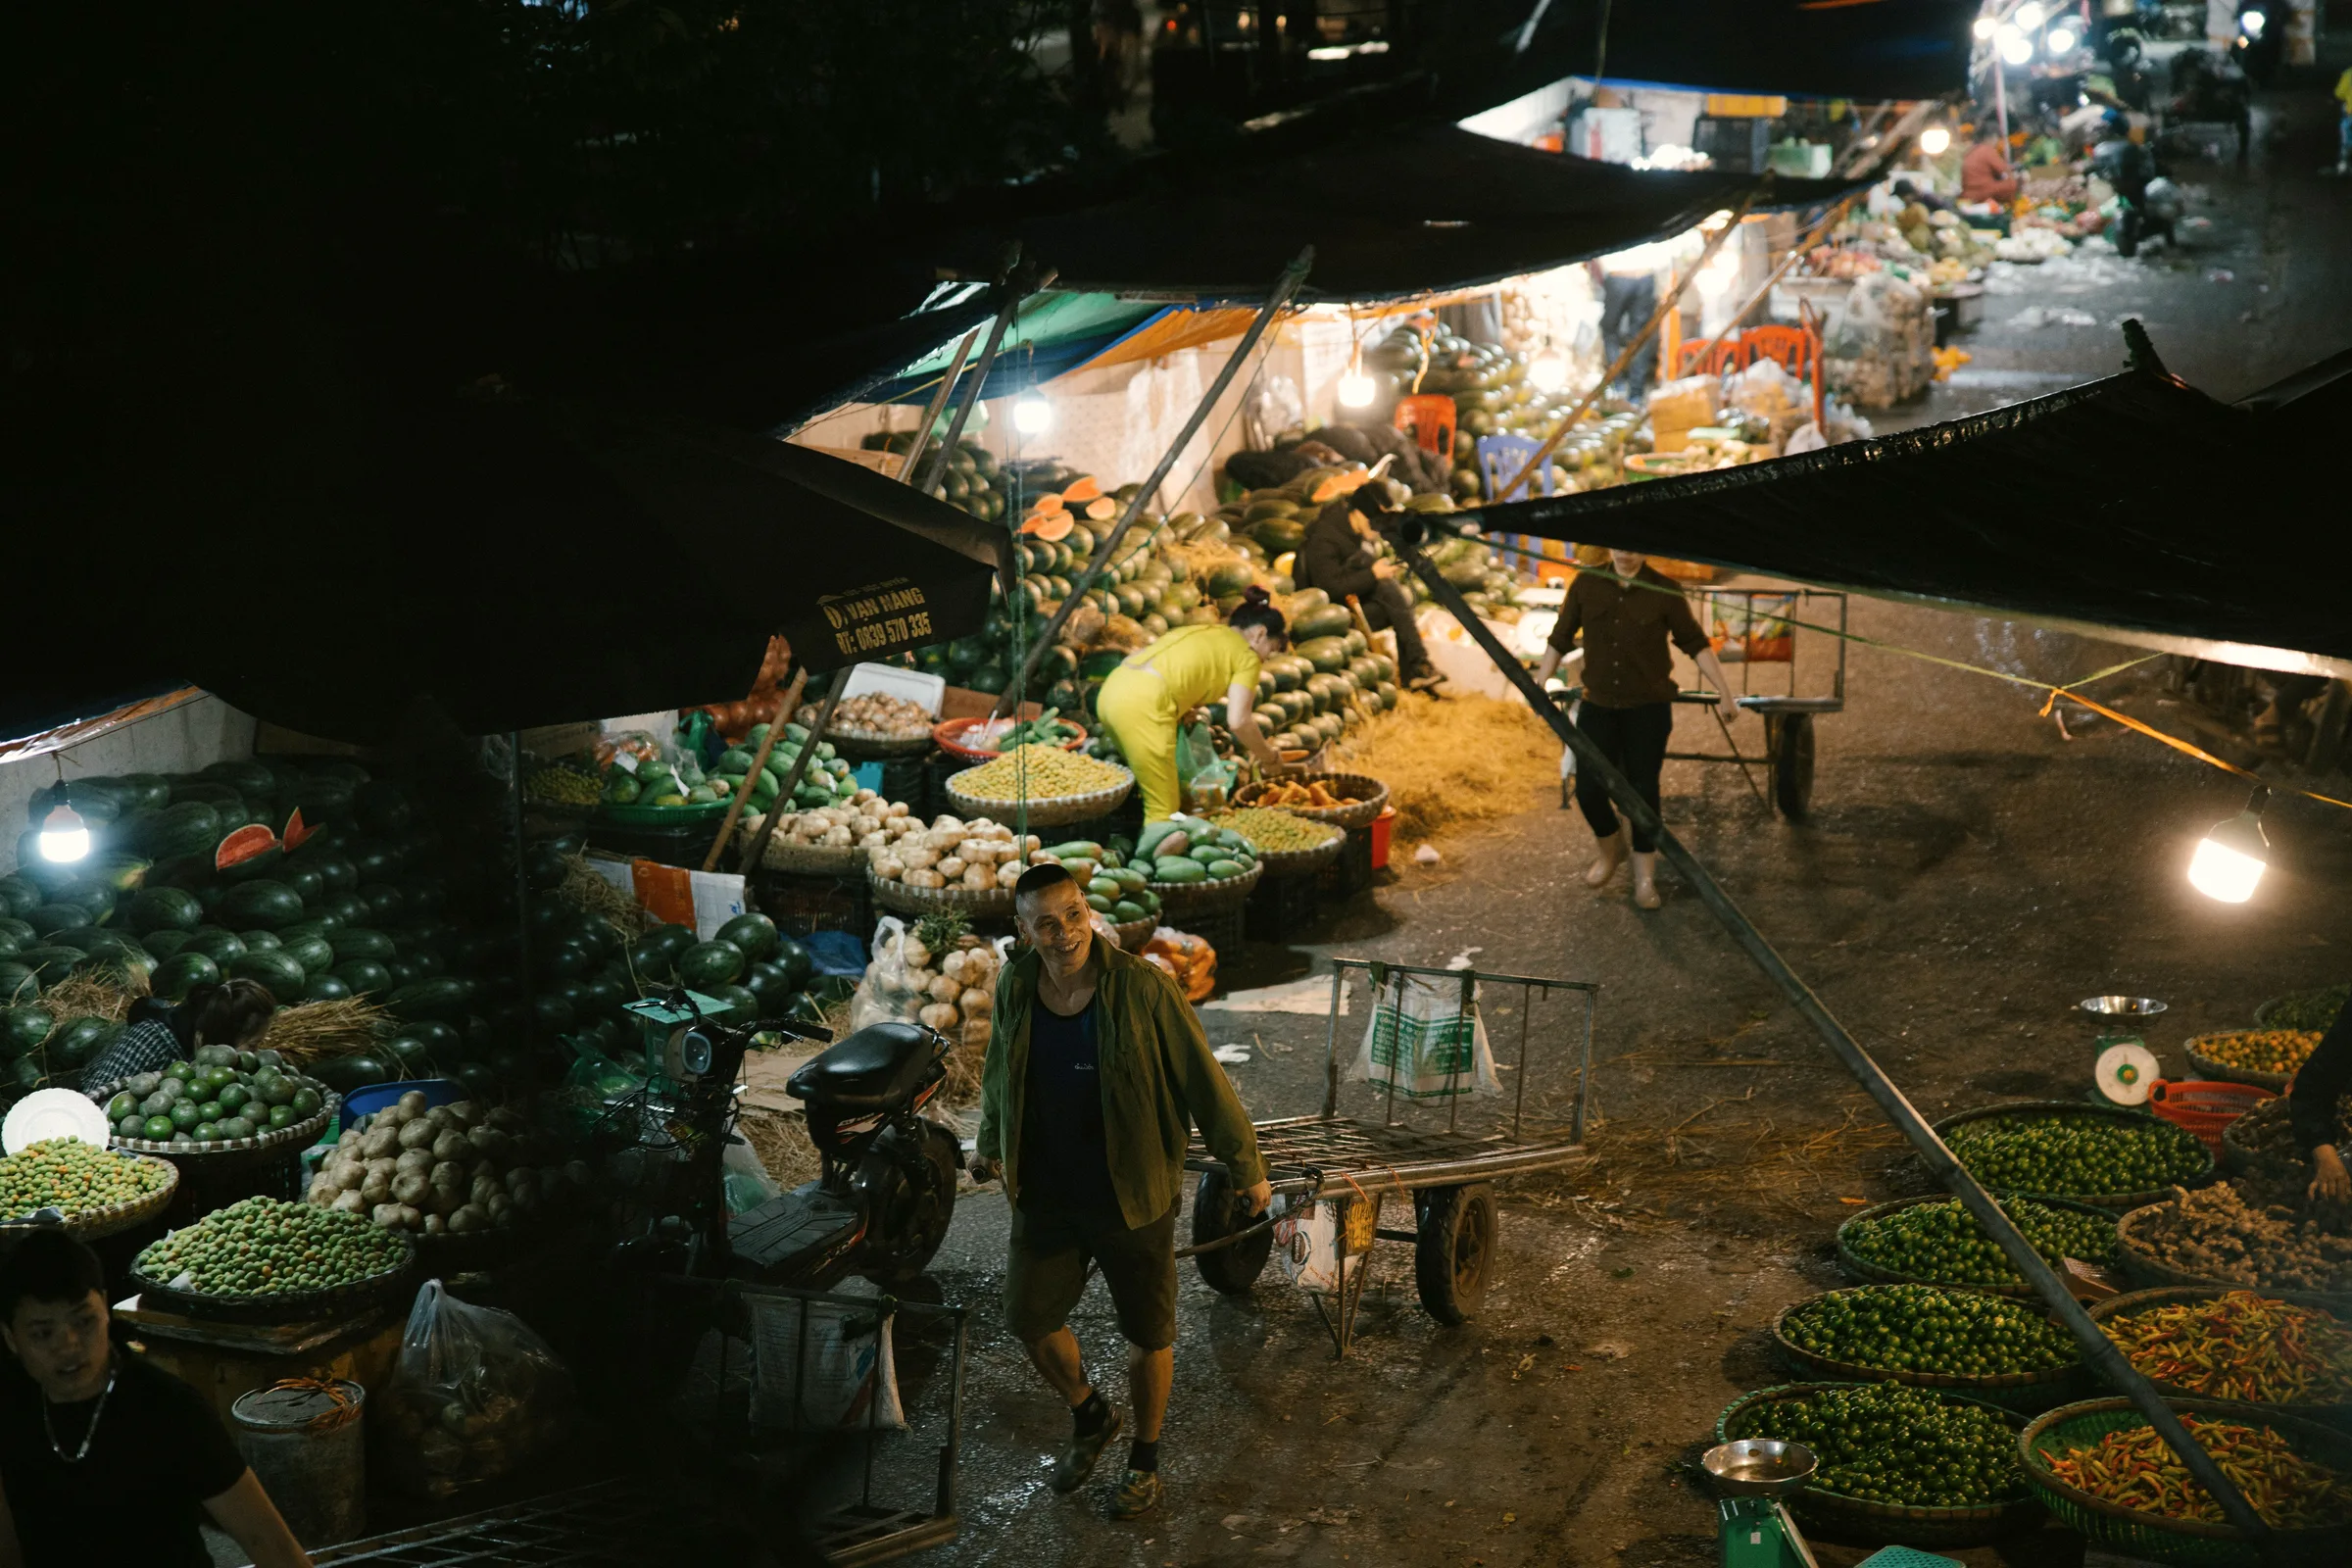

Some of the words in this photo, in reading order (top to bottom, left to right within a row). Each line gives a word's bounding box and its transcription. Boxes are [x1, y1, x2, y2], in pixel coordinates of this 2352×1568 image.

[844, 597, 881, 622] VẠN
[856, 622, 888, 651] 0839
[884, 617, 909, 644] 570
[907, 612, 933, 638] 335
